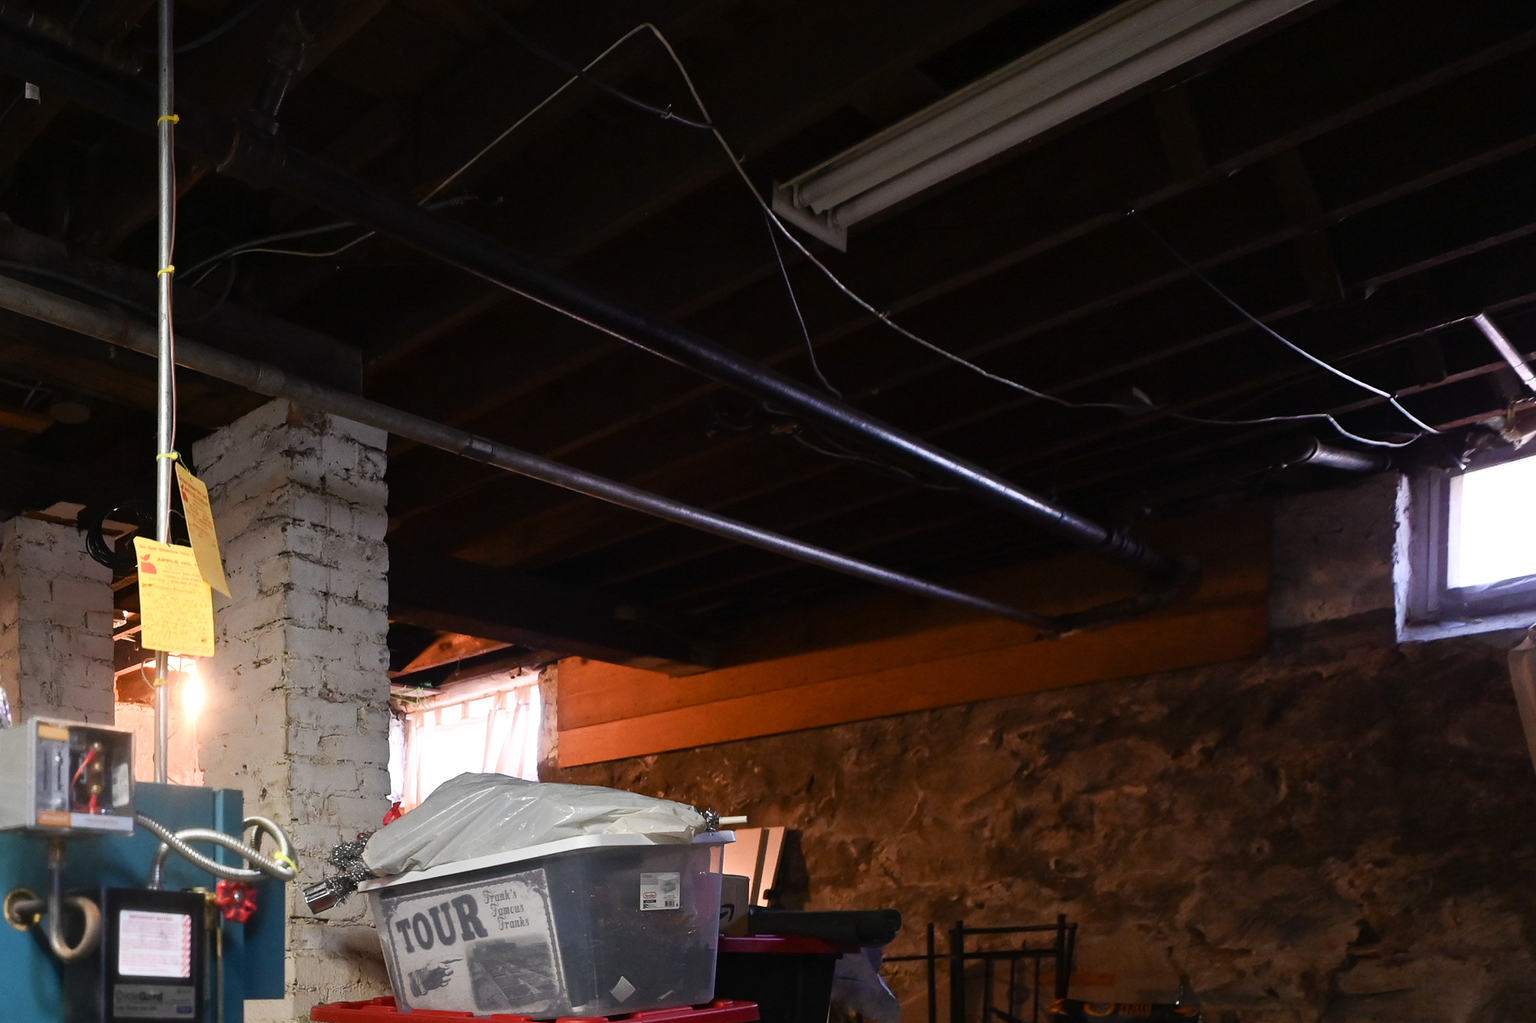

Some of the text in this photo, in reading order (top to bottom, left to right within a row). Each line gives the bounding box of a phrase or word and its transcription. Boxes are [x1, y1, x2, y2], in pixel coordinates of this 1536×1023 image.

[157, 557, 179, 565] APPLE
[482, 888, 518, 905] Frank's
[490, 903, 525, 918] Famous
[395, 893, 489, 954] TOUR
[497, 917, 531, 931] Franks
